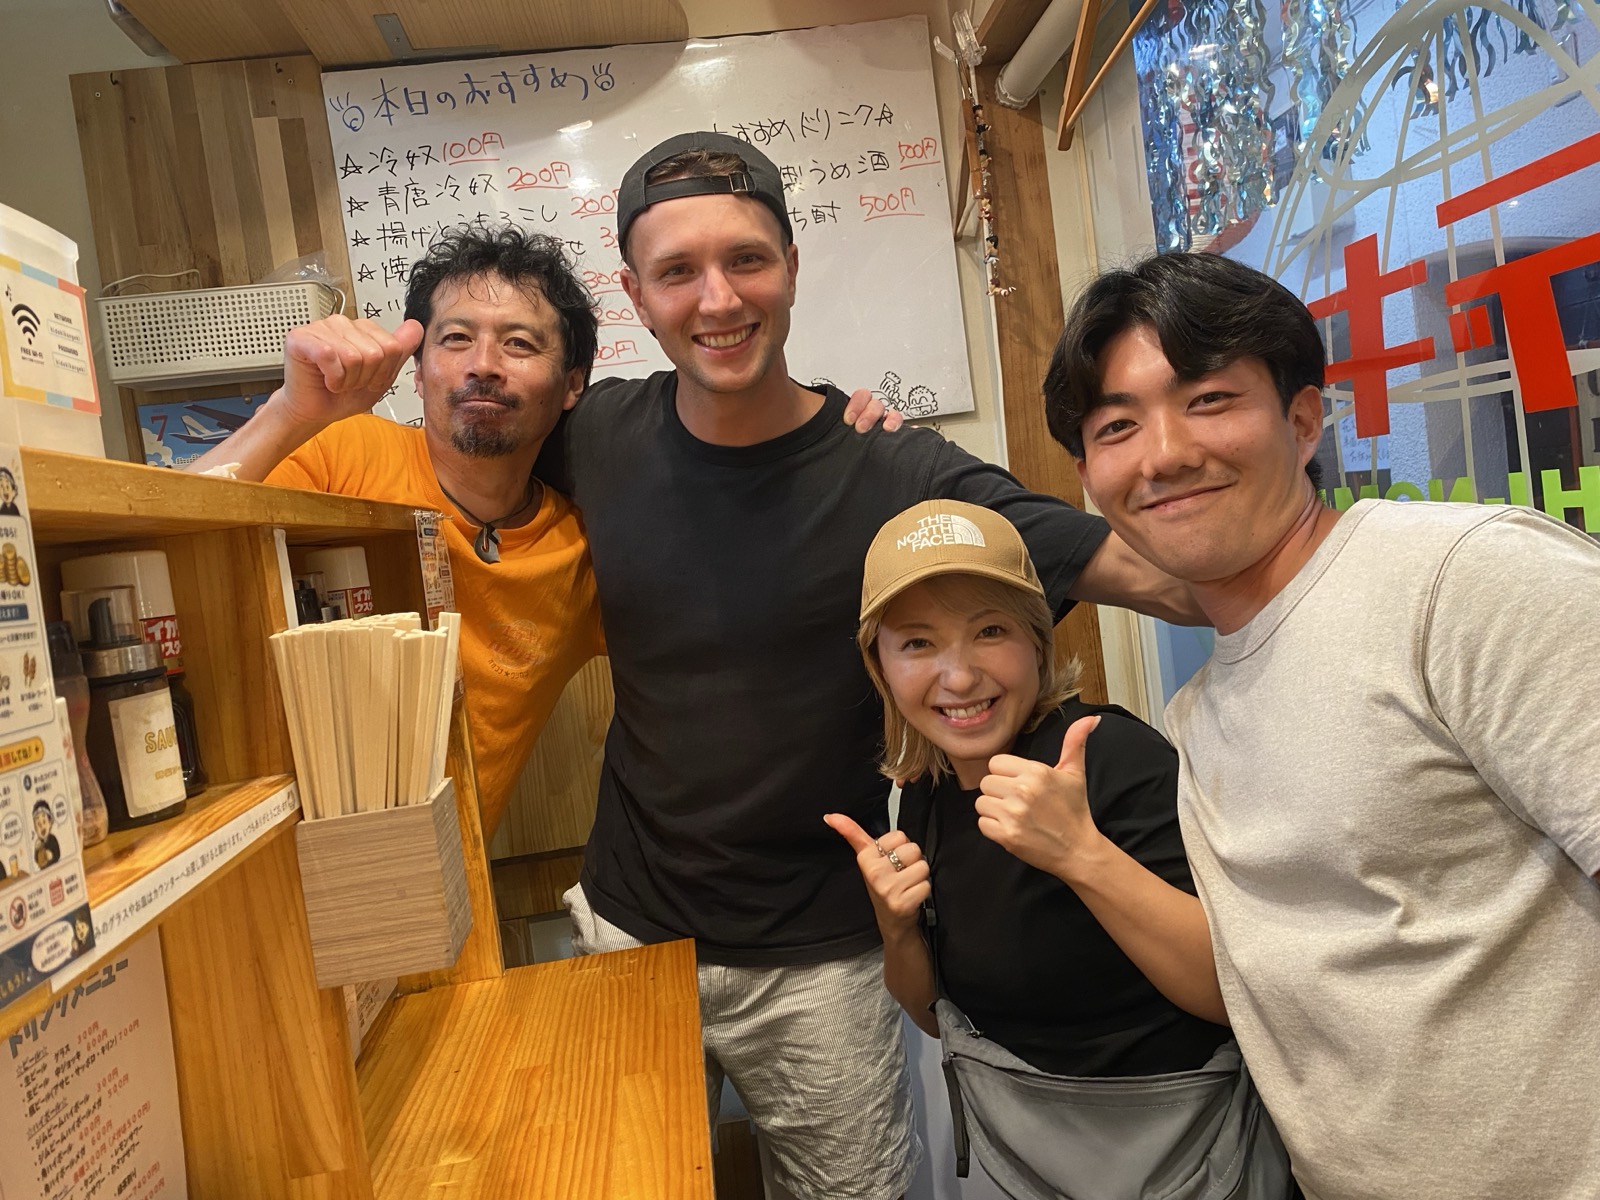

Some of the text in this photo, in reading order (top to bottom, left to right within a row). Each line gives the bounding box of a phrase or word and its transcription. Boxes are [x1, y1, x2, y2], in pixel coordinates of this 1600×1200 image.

[372, 64, 588, 125] 本日のおすすめ
[368, 132, 504, 177] 冷奴 100円
[378, 161, 571, 216] 青唐冷奴 200円
[858, 187, 915, 216] 500円
[917, 513, 951, 528] THE
[896, 523, 953, 550] NORTH
[911, 533, 955, 552] FACE
